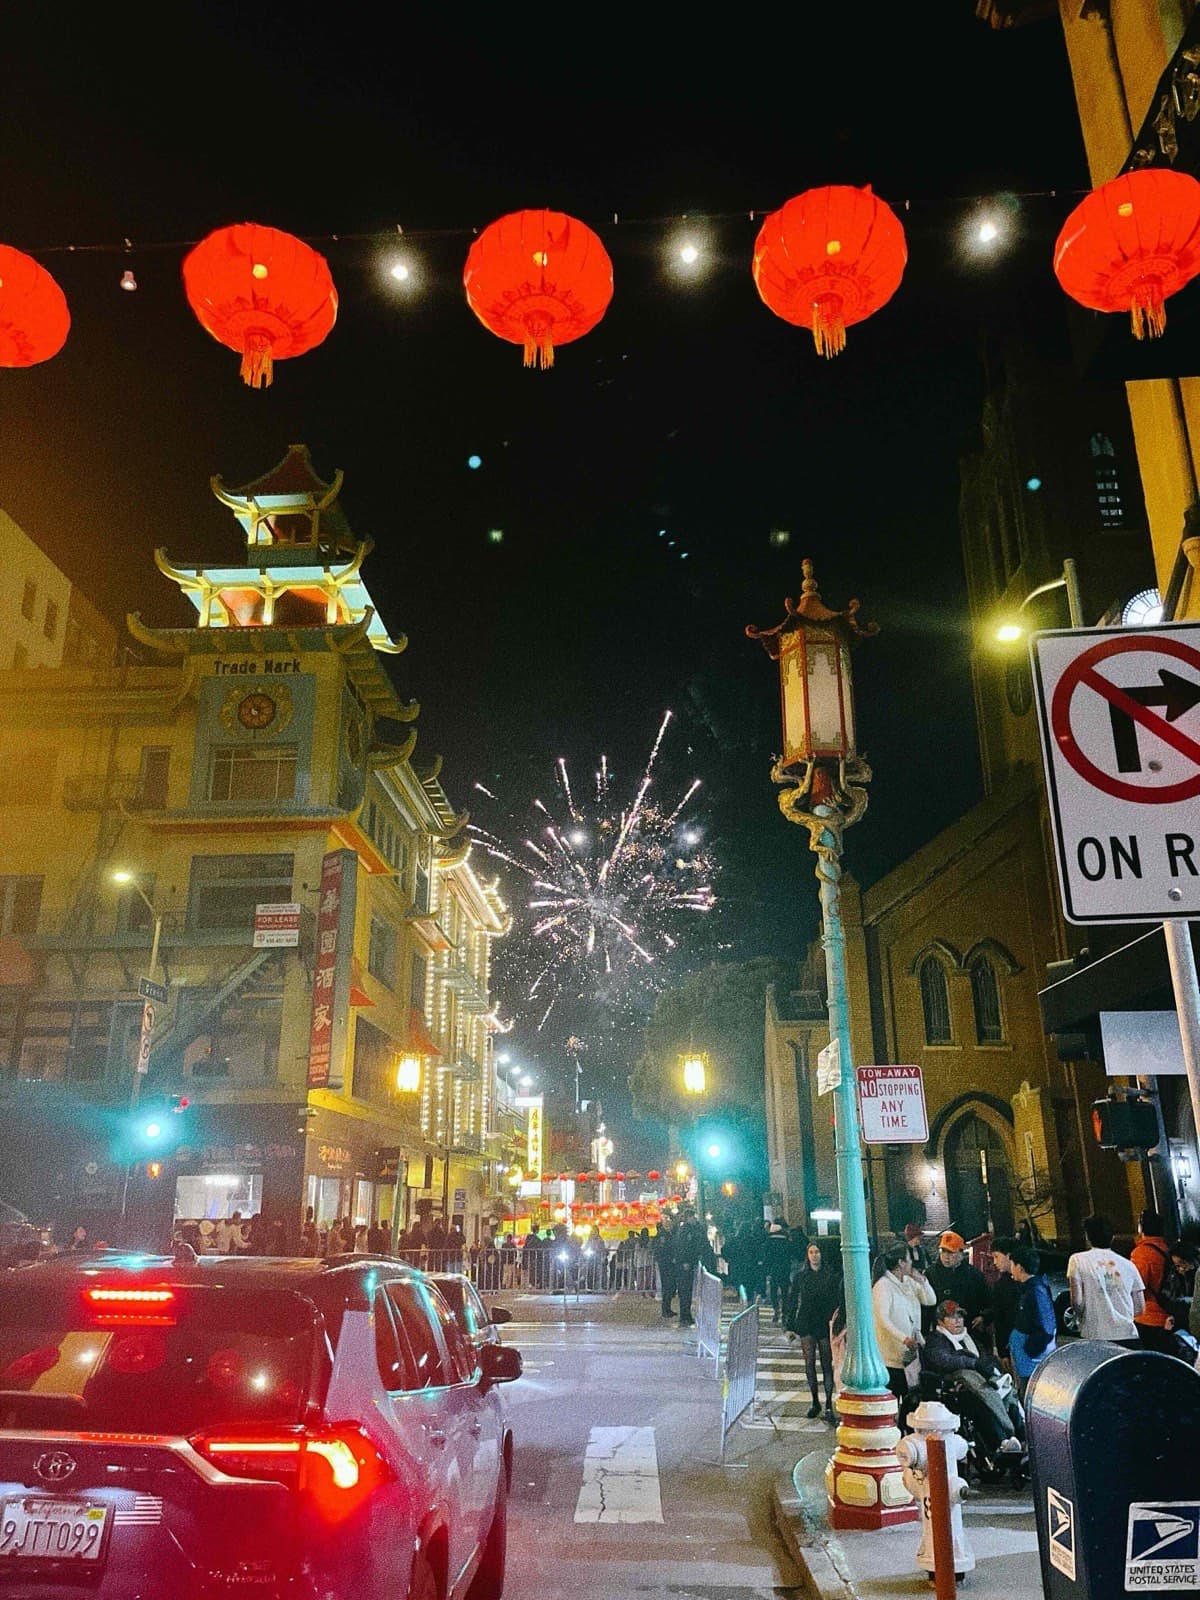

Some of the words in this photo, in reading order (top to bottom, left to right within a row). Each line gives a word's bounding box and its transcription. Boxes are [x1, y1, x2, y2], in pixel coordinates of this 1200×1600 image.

[214, 660, 257, 674] Trade
[264, 659, 301, 673] Mark
[1077, 835, 1142, 881] ON
[862, 1068, 917, 1078] TOW-AWAY
[861, 1080, 877, 1097] NO
[878, 1083, 920, 1097] STOPPING
[881, 1100, 904, 1113] ANY
[880, 1115, 908, 1129] TIME
[0, 1520, 99, 1553] 9JTT099
[1129, 1565, 1164, 1576] UNITED
[1165, 1565, 1196, 1574] STATES
[1129, 1575, 1162, 1585] POSTAL
[1163, 1574, 1199, 1585] SERVICE
